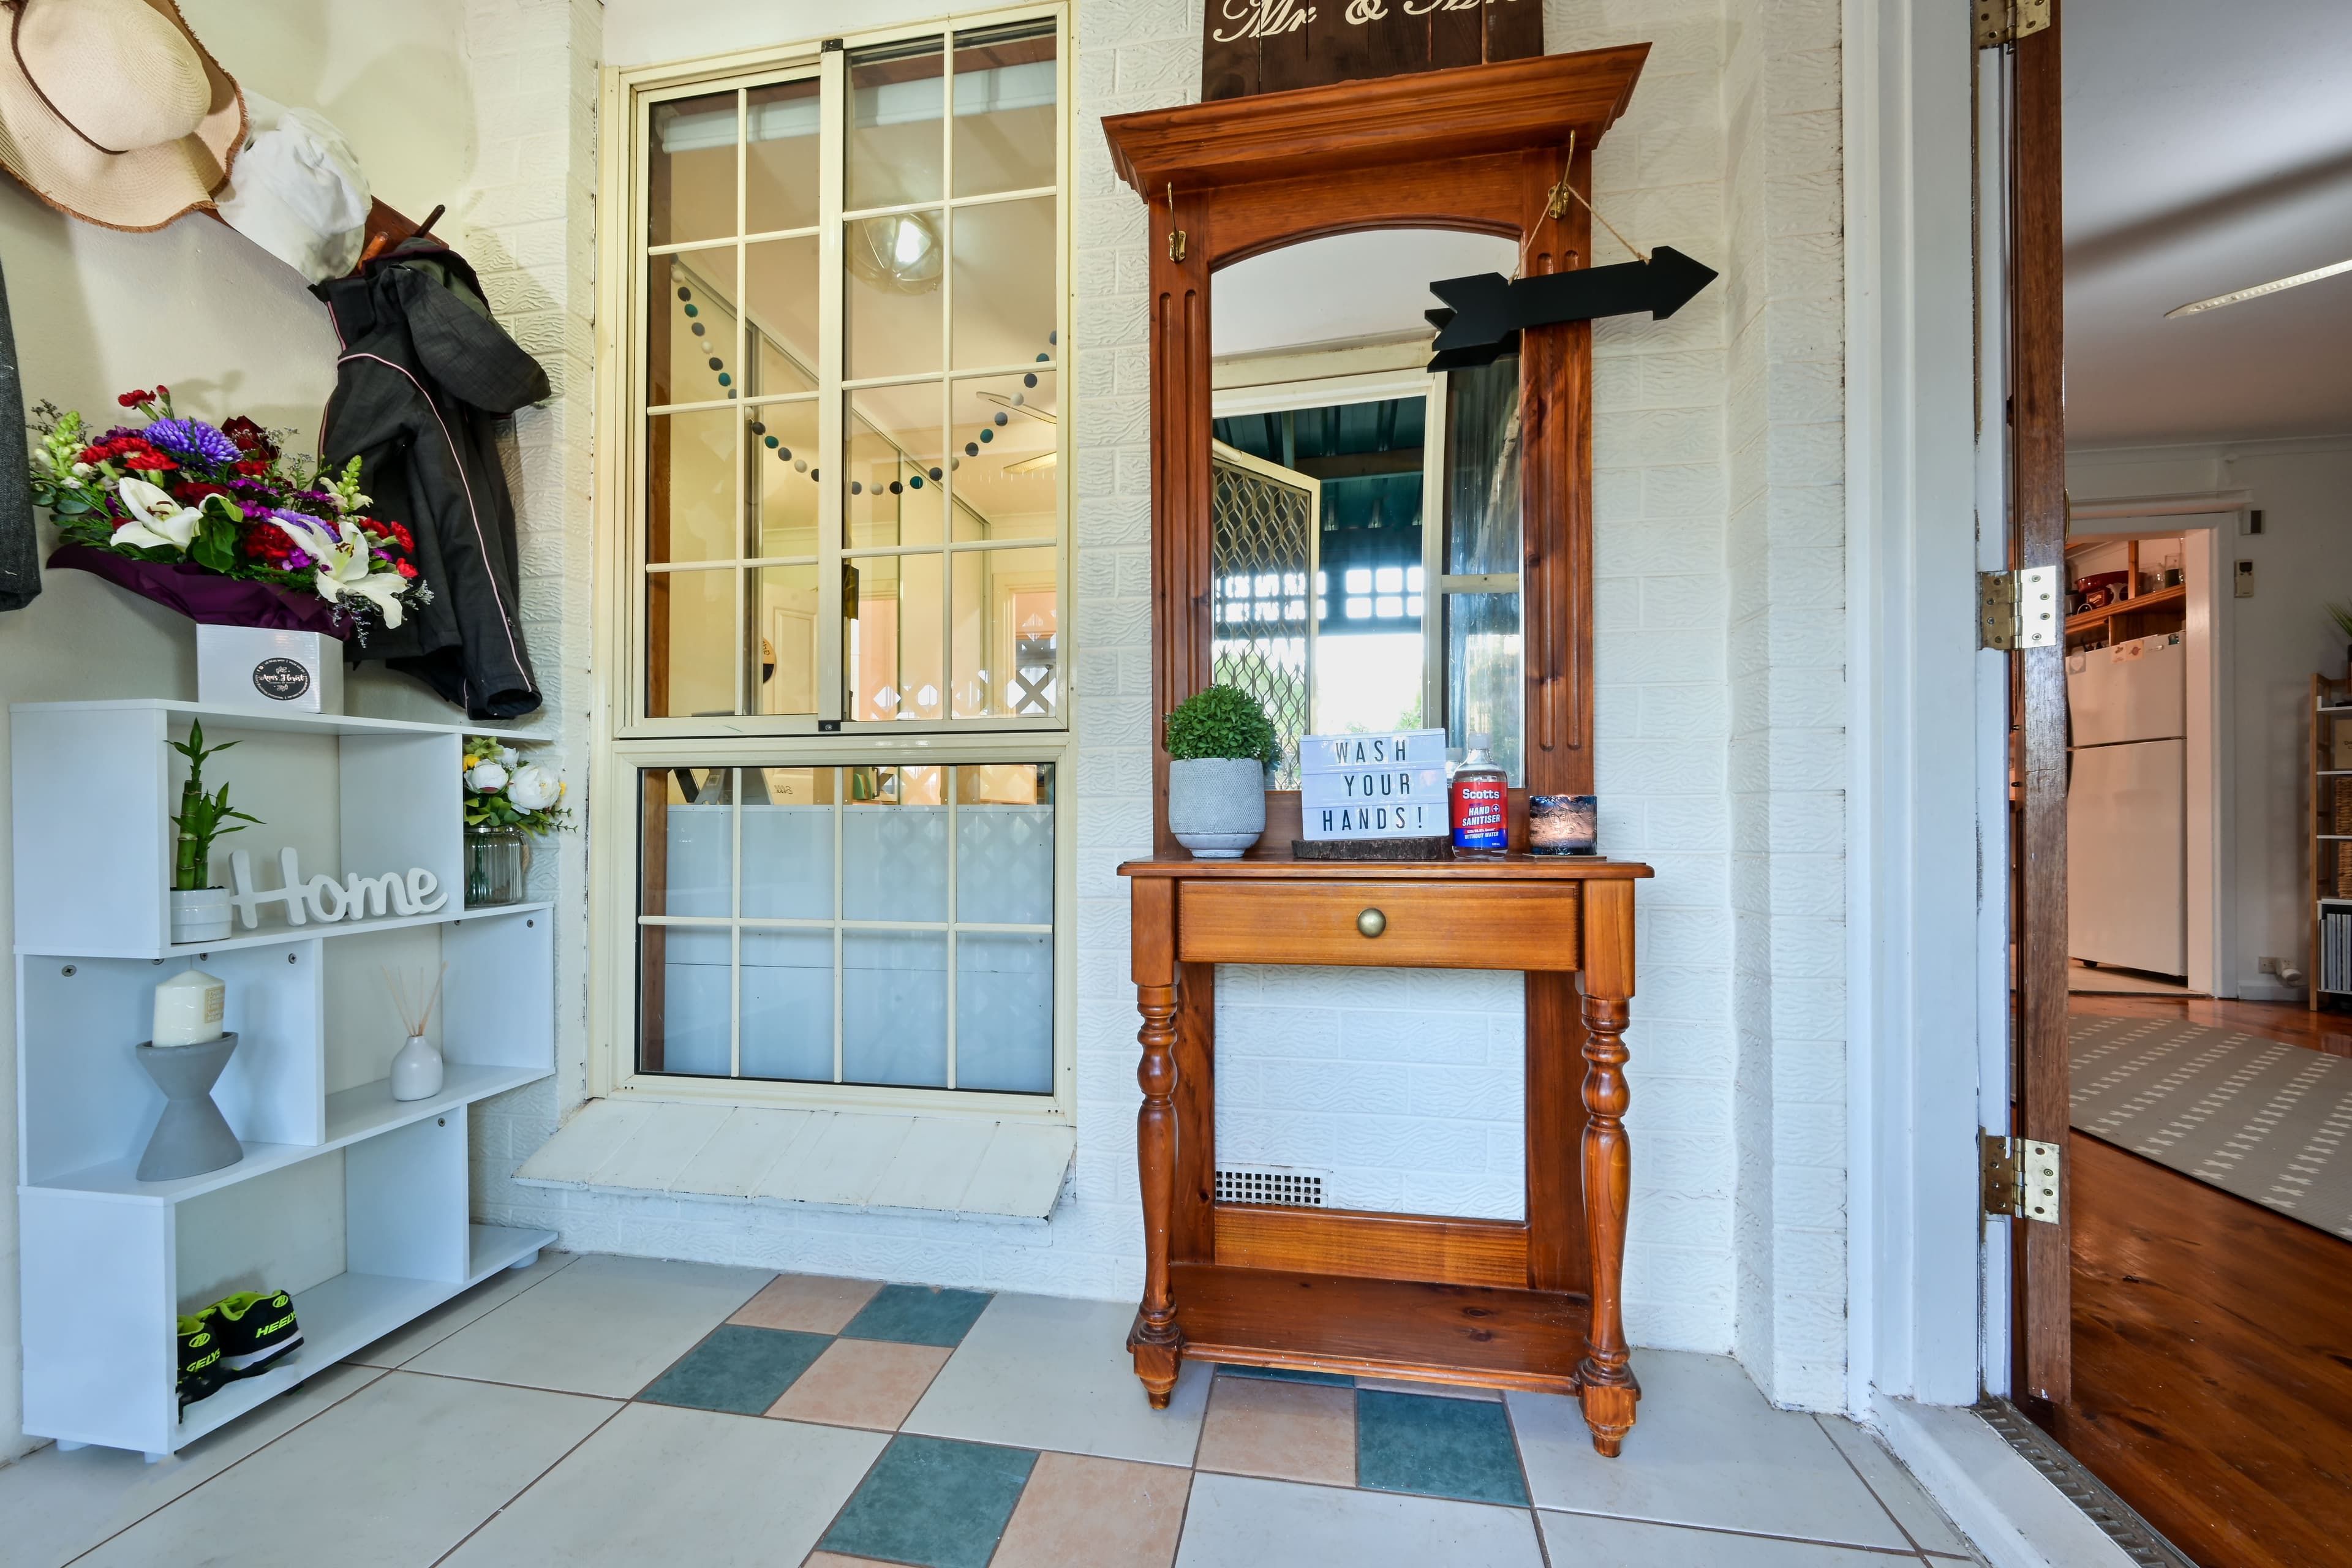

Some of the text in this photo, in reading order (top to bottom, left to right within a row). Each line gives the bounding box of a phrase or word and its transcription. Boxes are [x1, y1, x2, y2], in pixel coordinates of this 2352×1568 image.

[1335, 739, 1406, 764] WASH
[1344, 773, 1410, 797] YOUR
[1462, 788, 1501, 799] Scotts
[1322, 807, 1422, 831] HANDS!
[1462, 814, 1501, 826] SANITISER
[1469, 806, 1490, 816] HAND
[229, 846, 448, 930] Home
